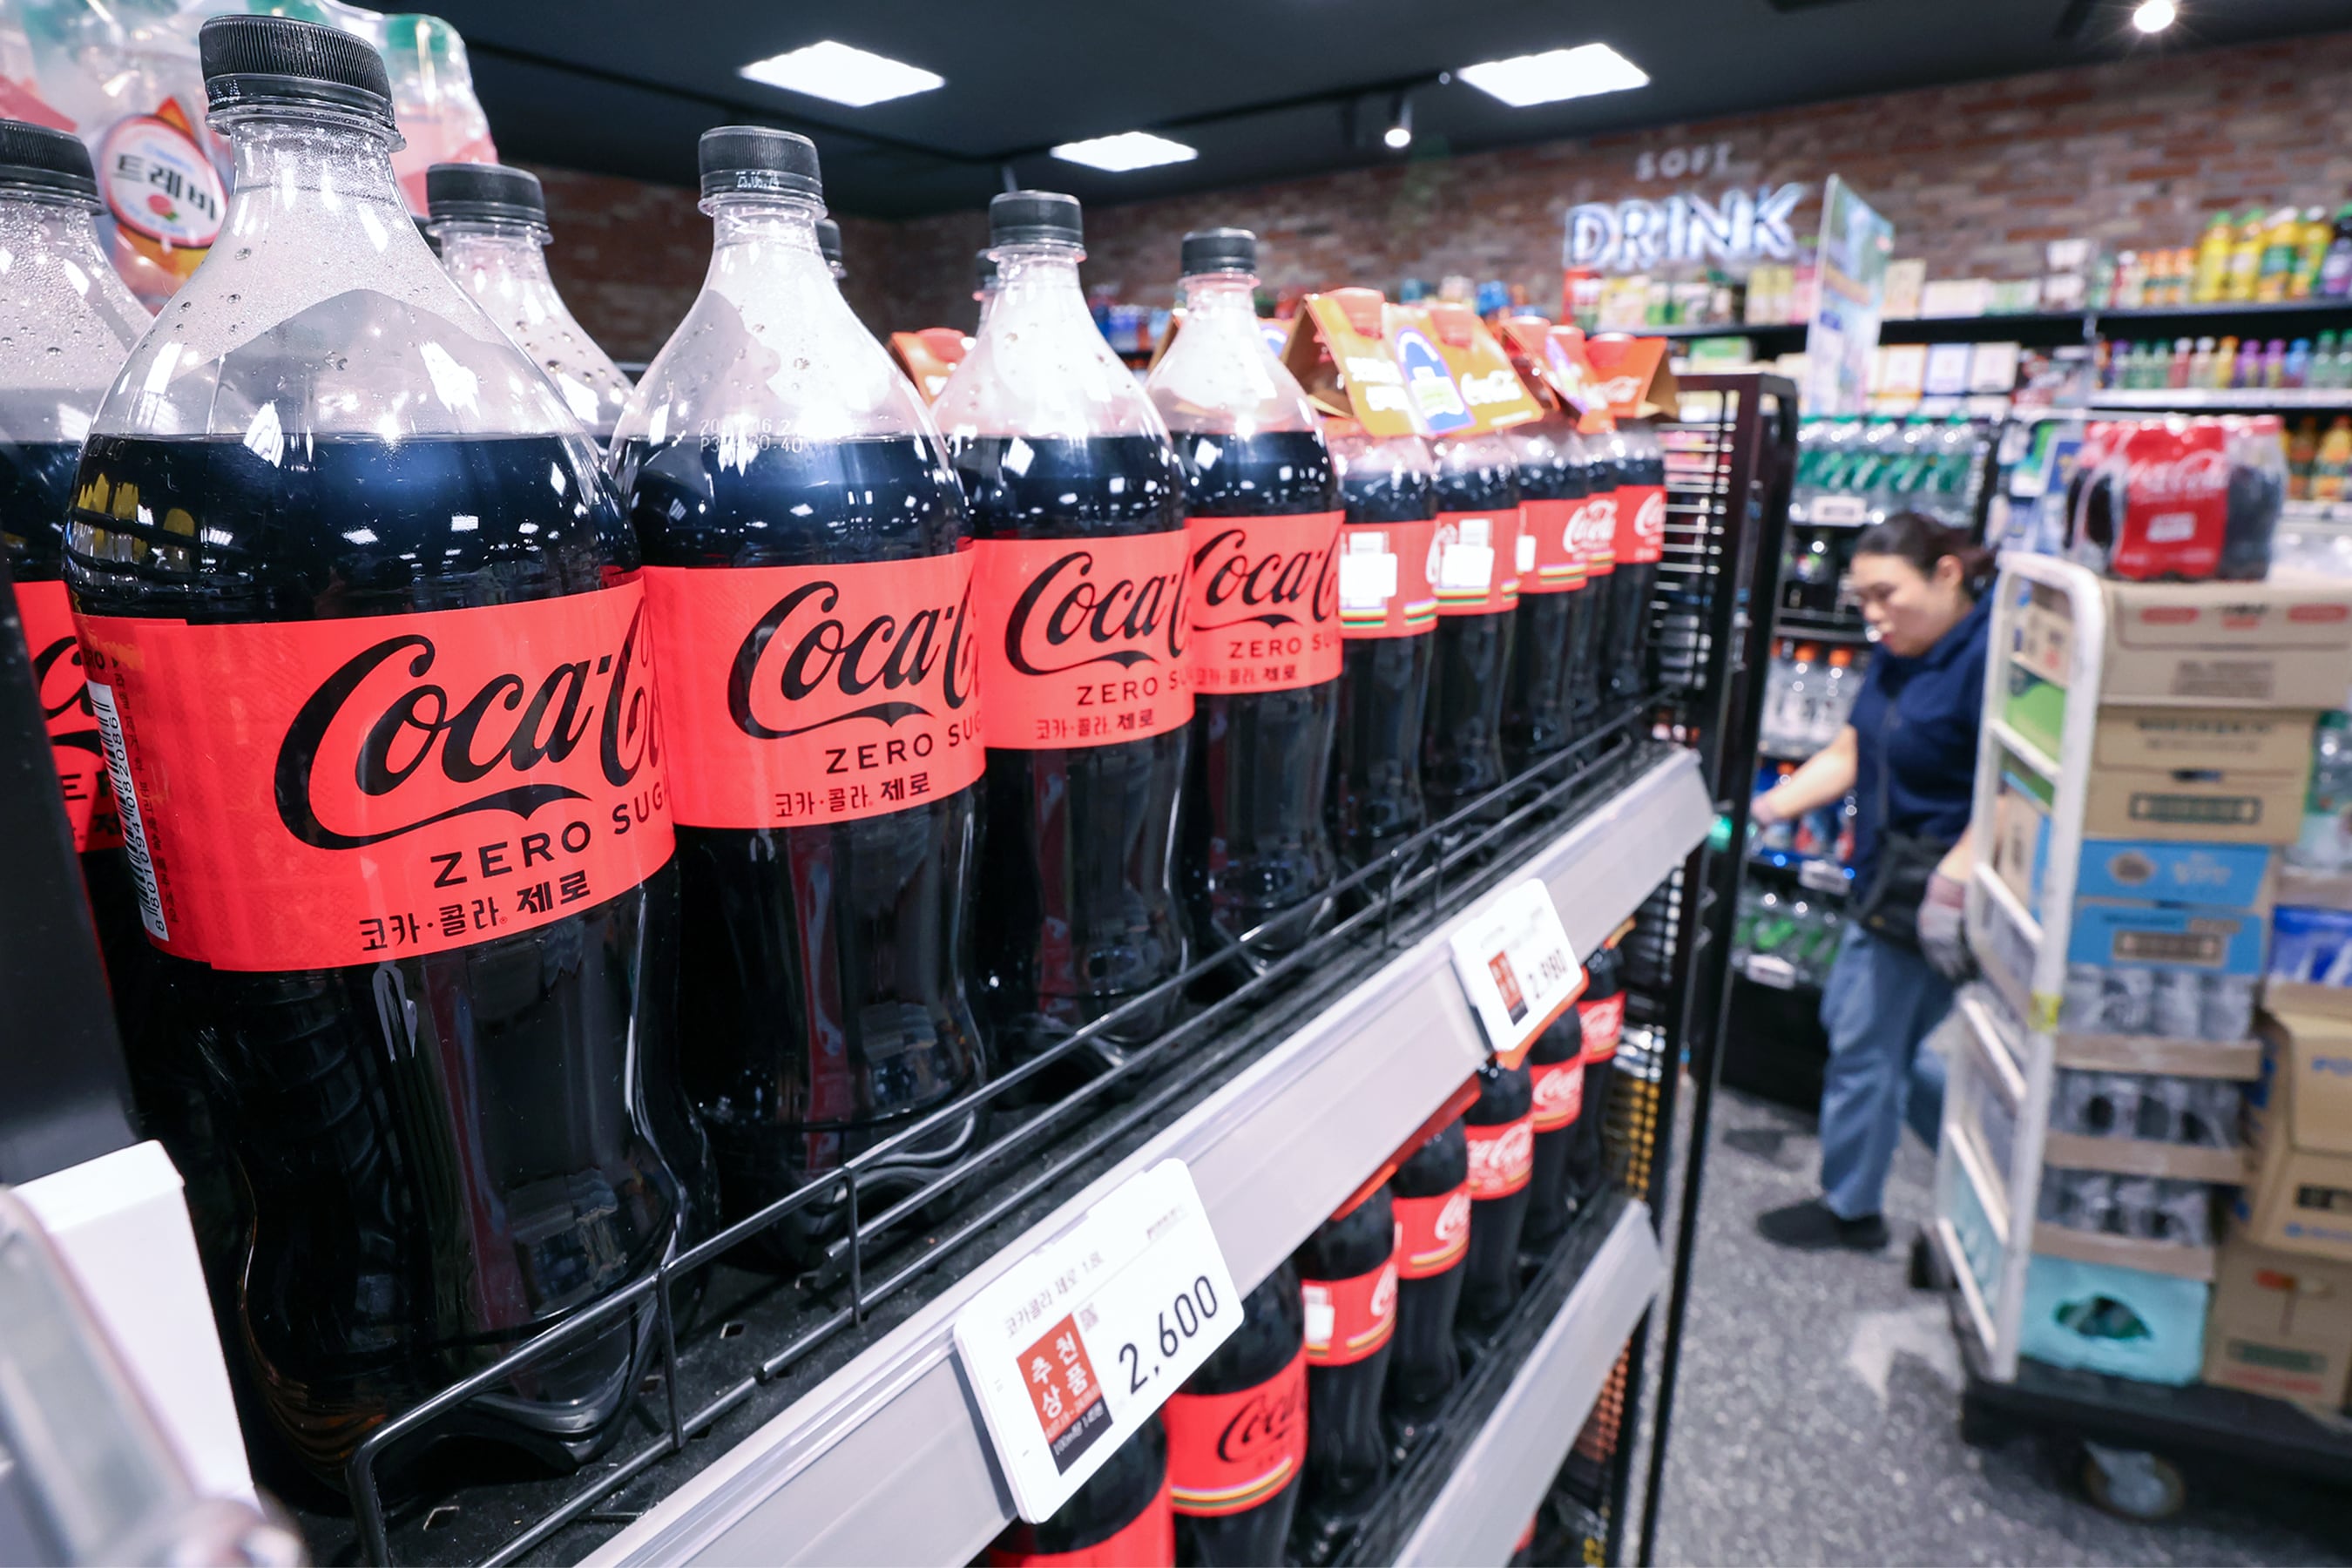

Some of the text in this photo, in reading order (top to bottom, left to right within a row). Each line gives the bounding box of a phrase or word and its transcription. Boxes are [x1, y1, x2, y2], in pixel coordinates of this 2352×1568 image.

[112, 153, 216, 221] 트레비
[1563, 182, 1807, 272] DRINK
[1229, 637, 1302, 659] ZERO
[1077, 677, 1159, 706] ZERO
[1117, 708, 1155, 731] 제로
[825, 733, 934, 775] ZERO
[774, 772, 931, 817] 코카·콜라 제로
[430, 774, 667, 889] ZERO SUG
[361, 871, 591, 952] 코카·콜라 제로
[1004, 1290, 1053, 1339] 코카콜라
[1055, 1268, 1079, 1295] 제로
[1119, 1275, 1219, 1395] 2,600
